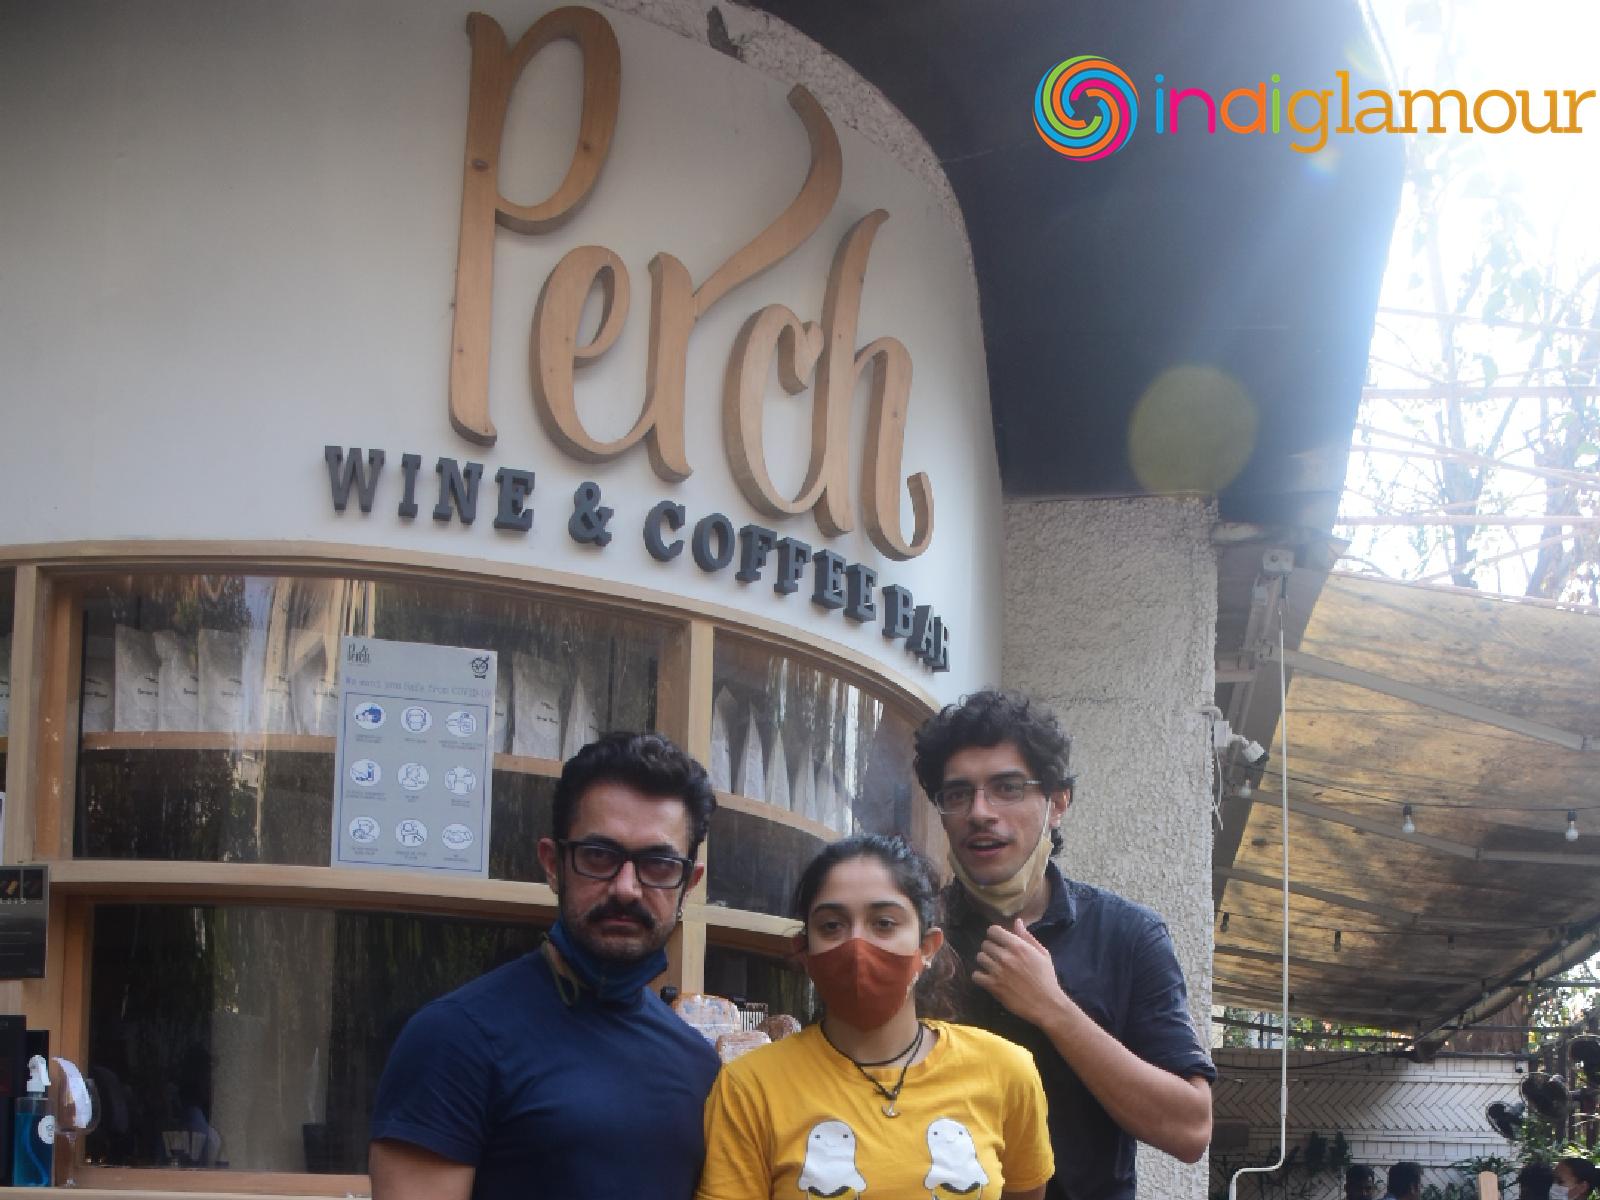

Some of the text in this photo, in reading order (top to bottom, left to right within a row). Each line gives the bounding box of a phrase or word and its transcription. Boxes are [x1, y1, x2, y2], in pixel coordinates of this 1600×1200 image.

[450, 5, 934, 562] Perch
[325, 445, 951, 673] WINE & COFFEE BAR
